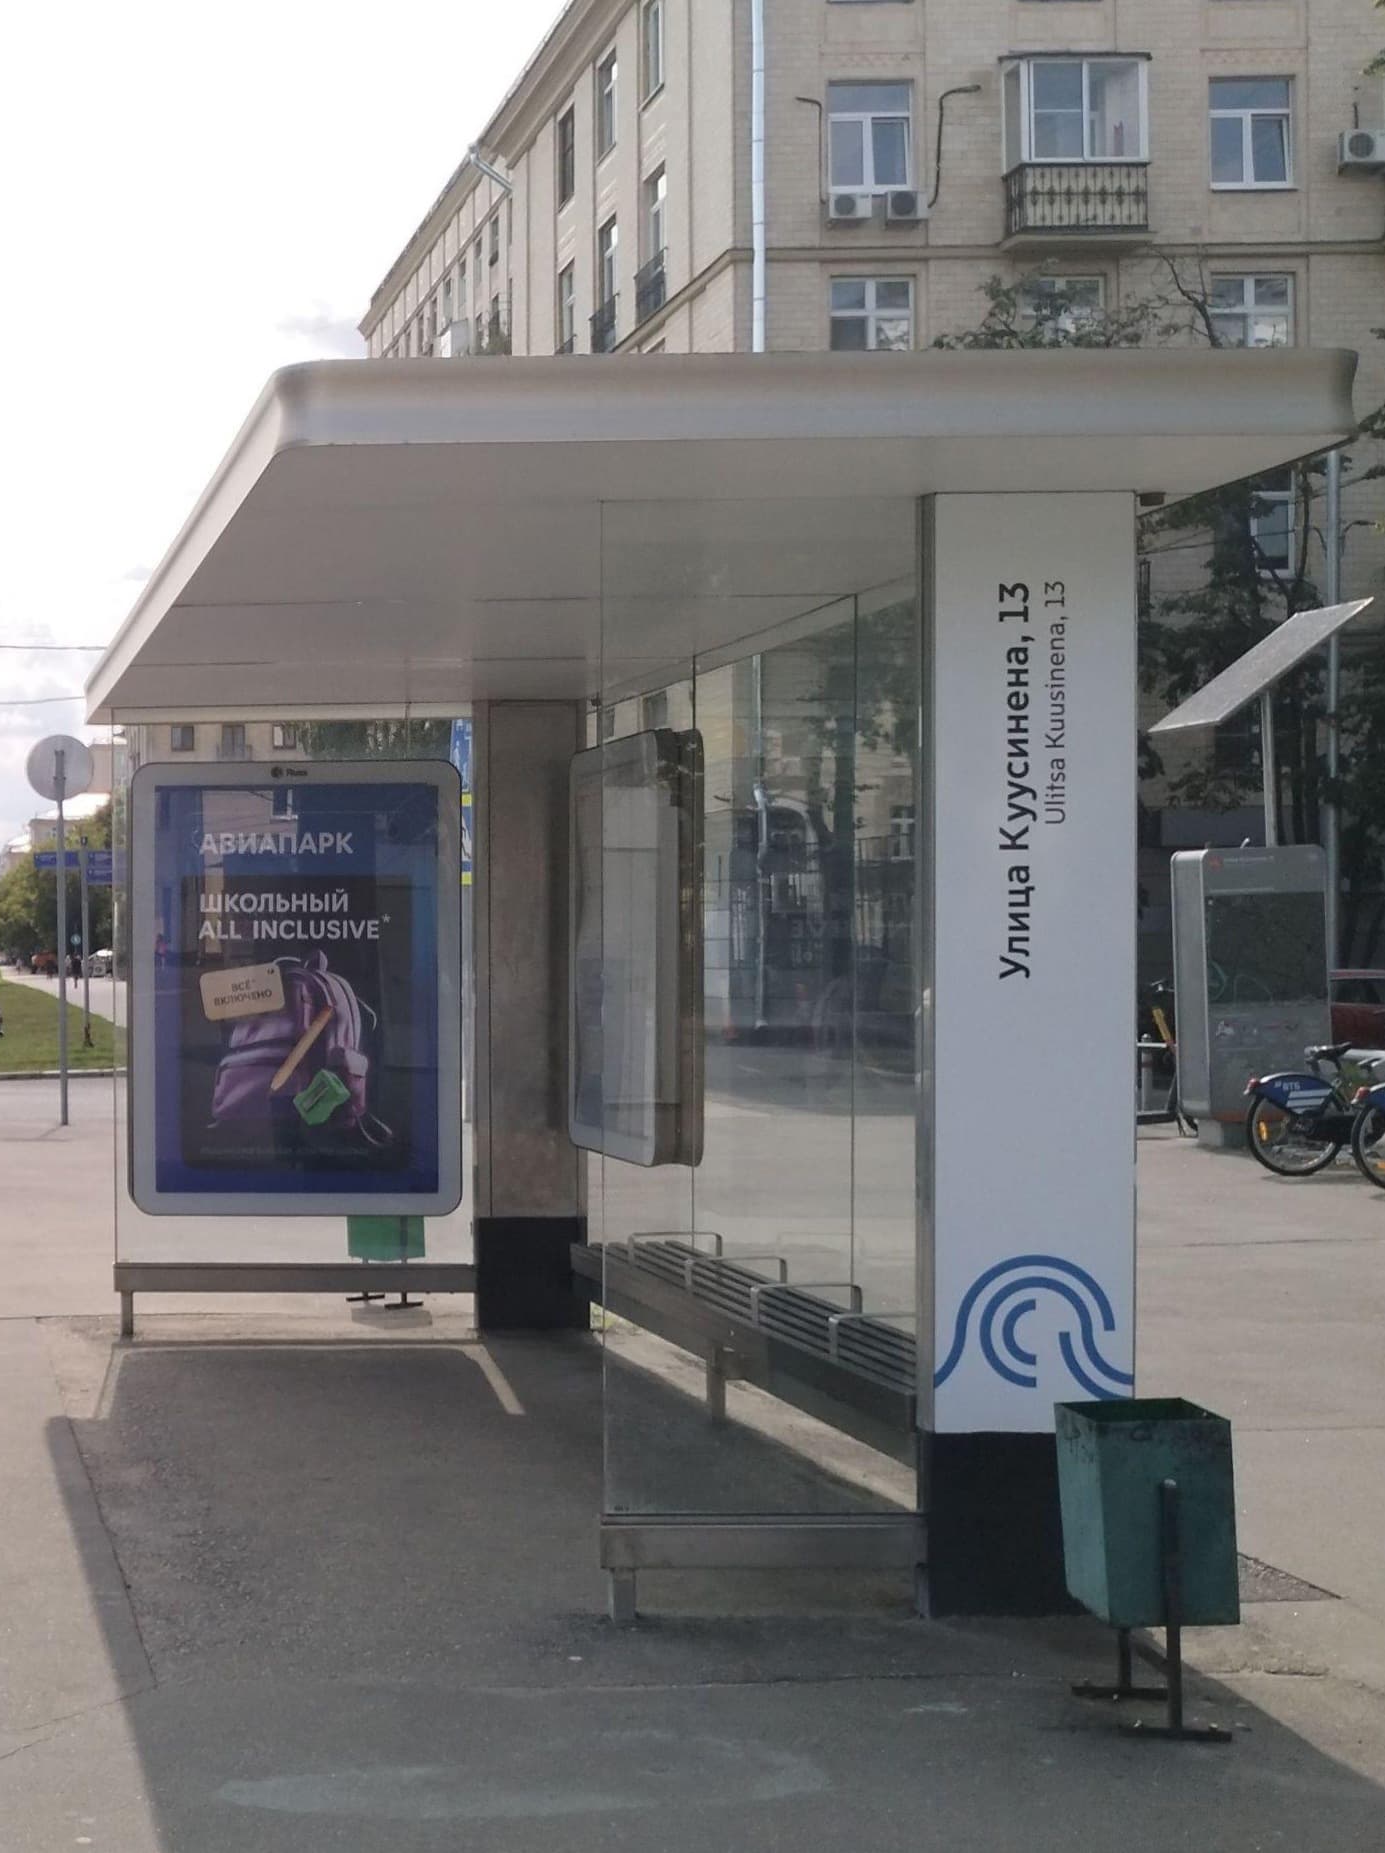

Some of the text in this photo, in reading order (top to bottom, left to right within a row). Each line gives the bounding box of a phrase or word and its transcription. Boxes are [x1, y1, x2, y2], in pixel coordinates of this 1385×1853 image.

[1043, 580, 1070, 825] Ulitsa Kuusinena, 13
[997, 581, 1040, 980] Улица Куусинена, 13
[198, 832, 354, 855] АВИАПАРК
[199, 888, 349, 913] ШКОЛЬНЫЙ
[198, 920, 242, 940] ALL
[213, 988, 273, 1007] ВКЛЮЧЕНО
